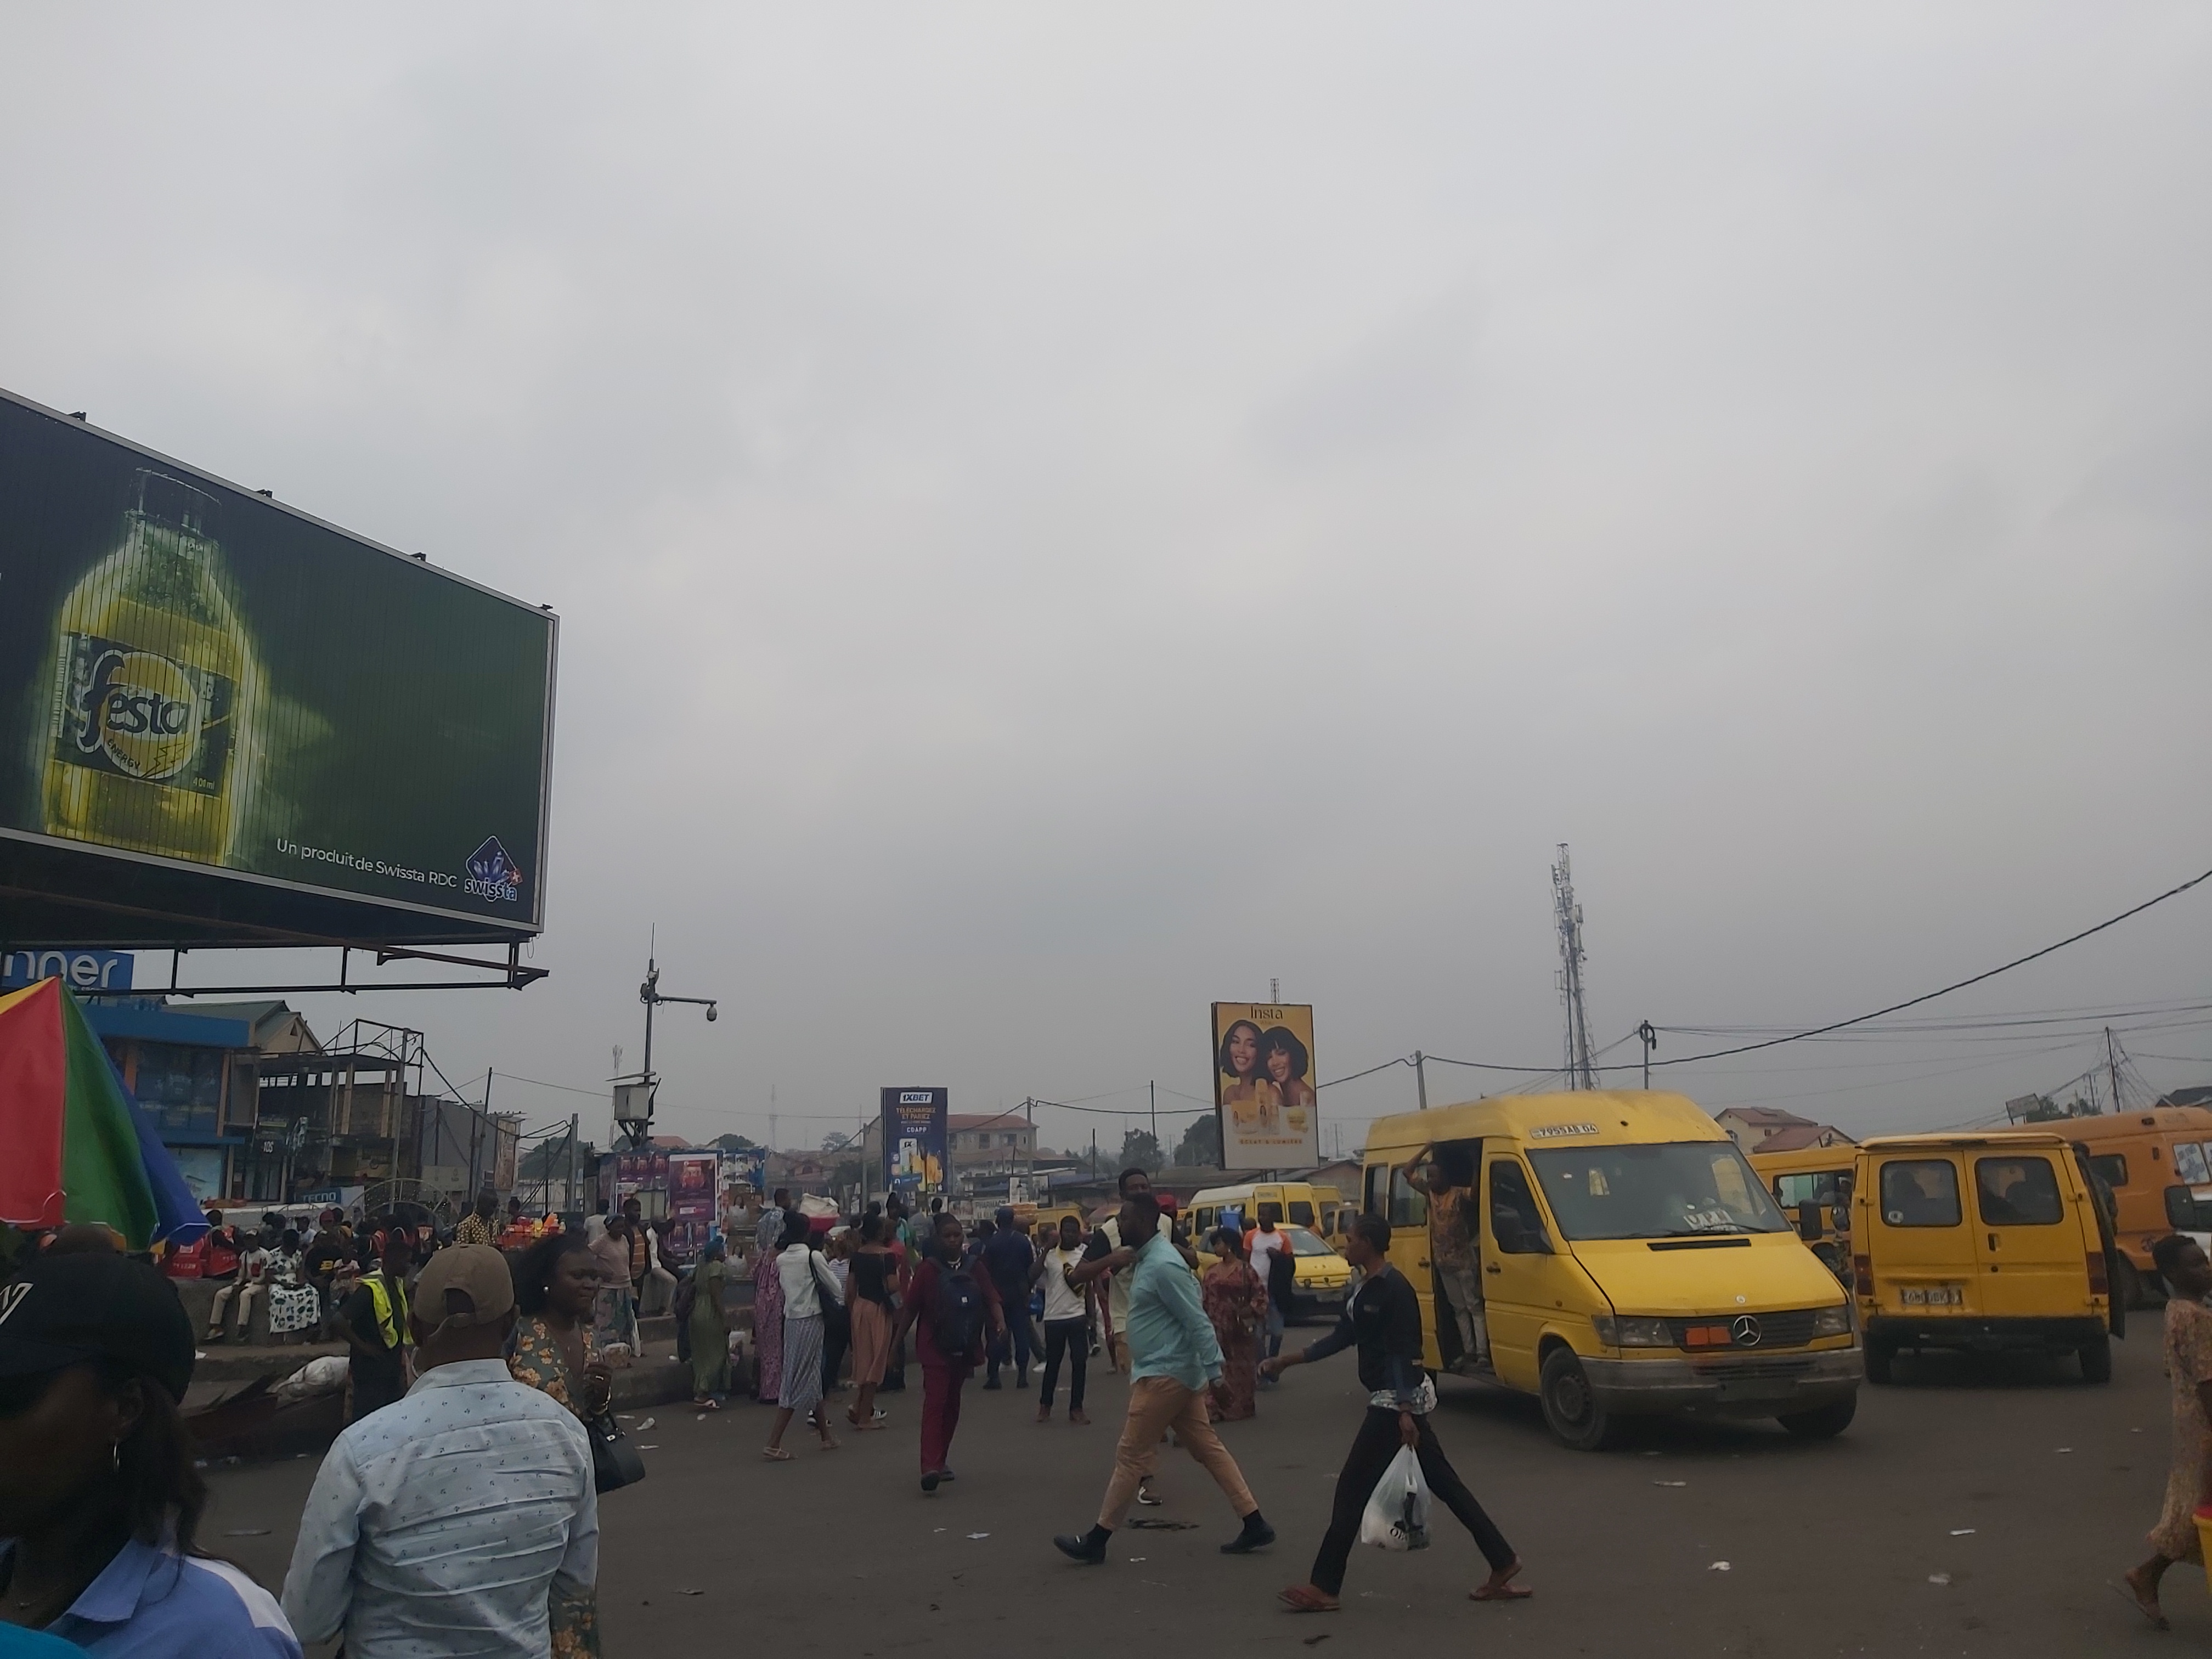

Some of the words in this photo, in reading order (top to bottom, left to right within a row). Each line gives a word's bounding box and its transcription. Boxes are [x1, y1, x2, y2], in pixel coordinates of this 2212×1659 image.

[77, 651, 191, 749] festa
[107, 738, 141, 769] ENERGY
[276, 837, 297, 855] Un
[301, 845, 354, 867] produit
[354, 856, 374, 872] de
[375, 861, 425, 883] Swissta
[428, 871, 458, 888] RDC
[464, 878, 517, 902] swissta
[1250, 1006, 1283, 1019] Insta
[902, 1093, 930, 1102] 1XBET
